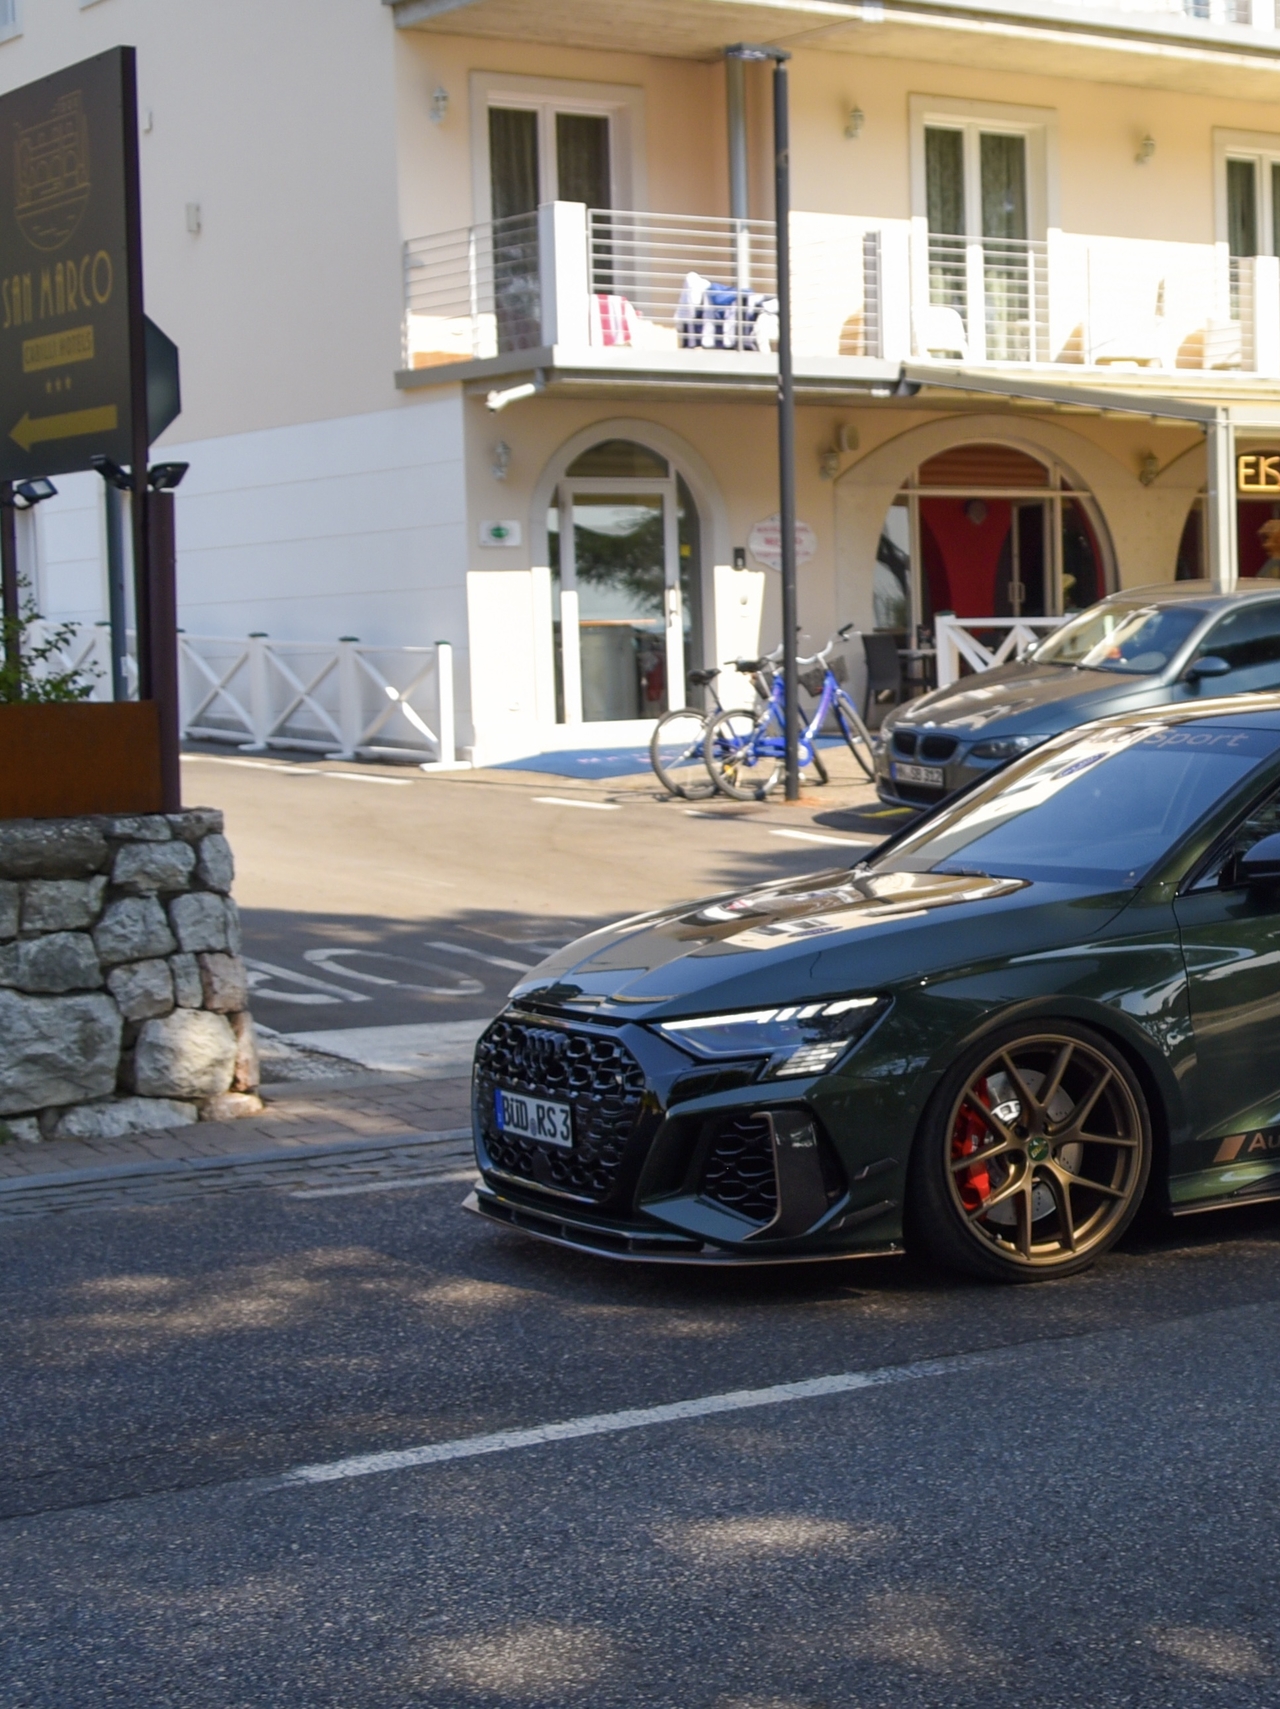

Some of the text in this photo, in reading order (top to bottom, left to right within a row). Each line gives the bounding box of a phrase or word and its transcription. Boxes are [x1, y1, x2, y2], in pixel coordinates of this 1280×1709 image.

[3, 250, 113, 328] SAN MARCO
[1143, 728, 1249, 748] Sport
[502, 1095, 570, 1141] BÜD RS 3
